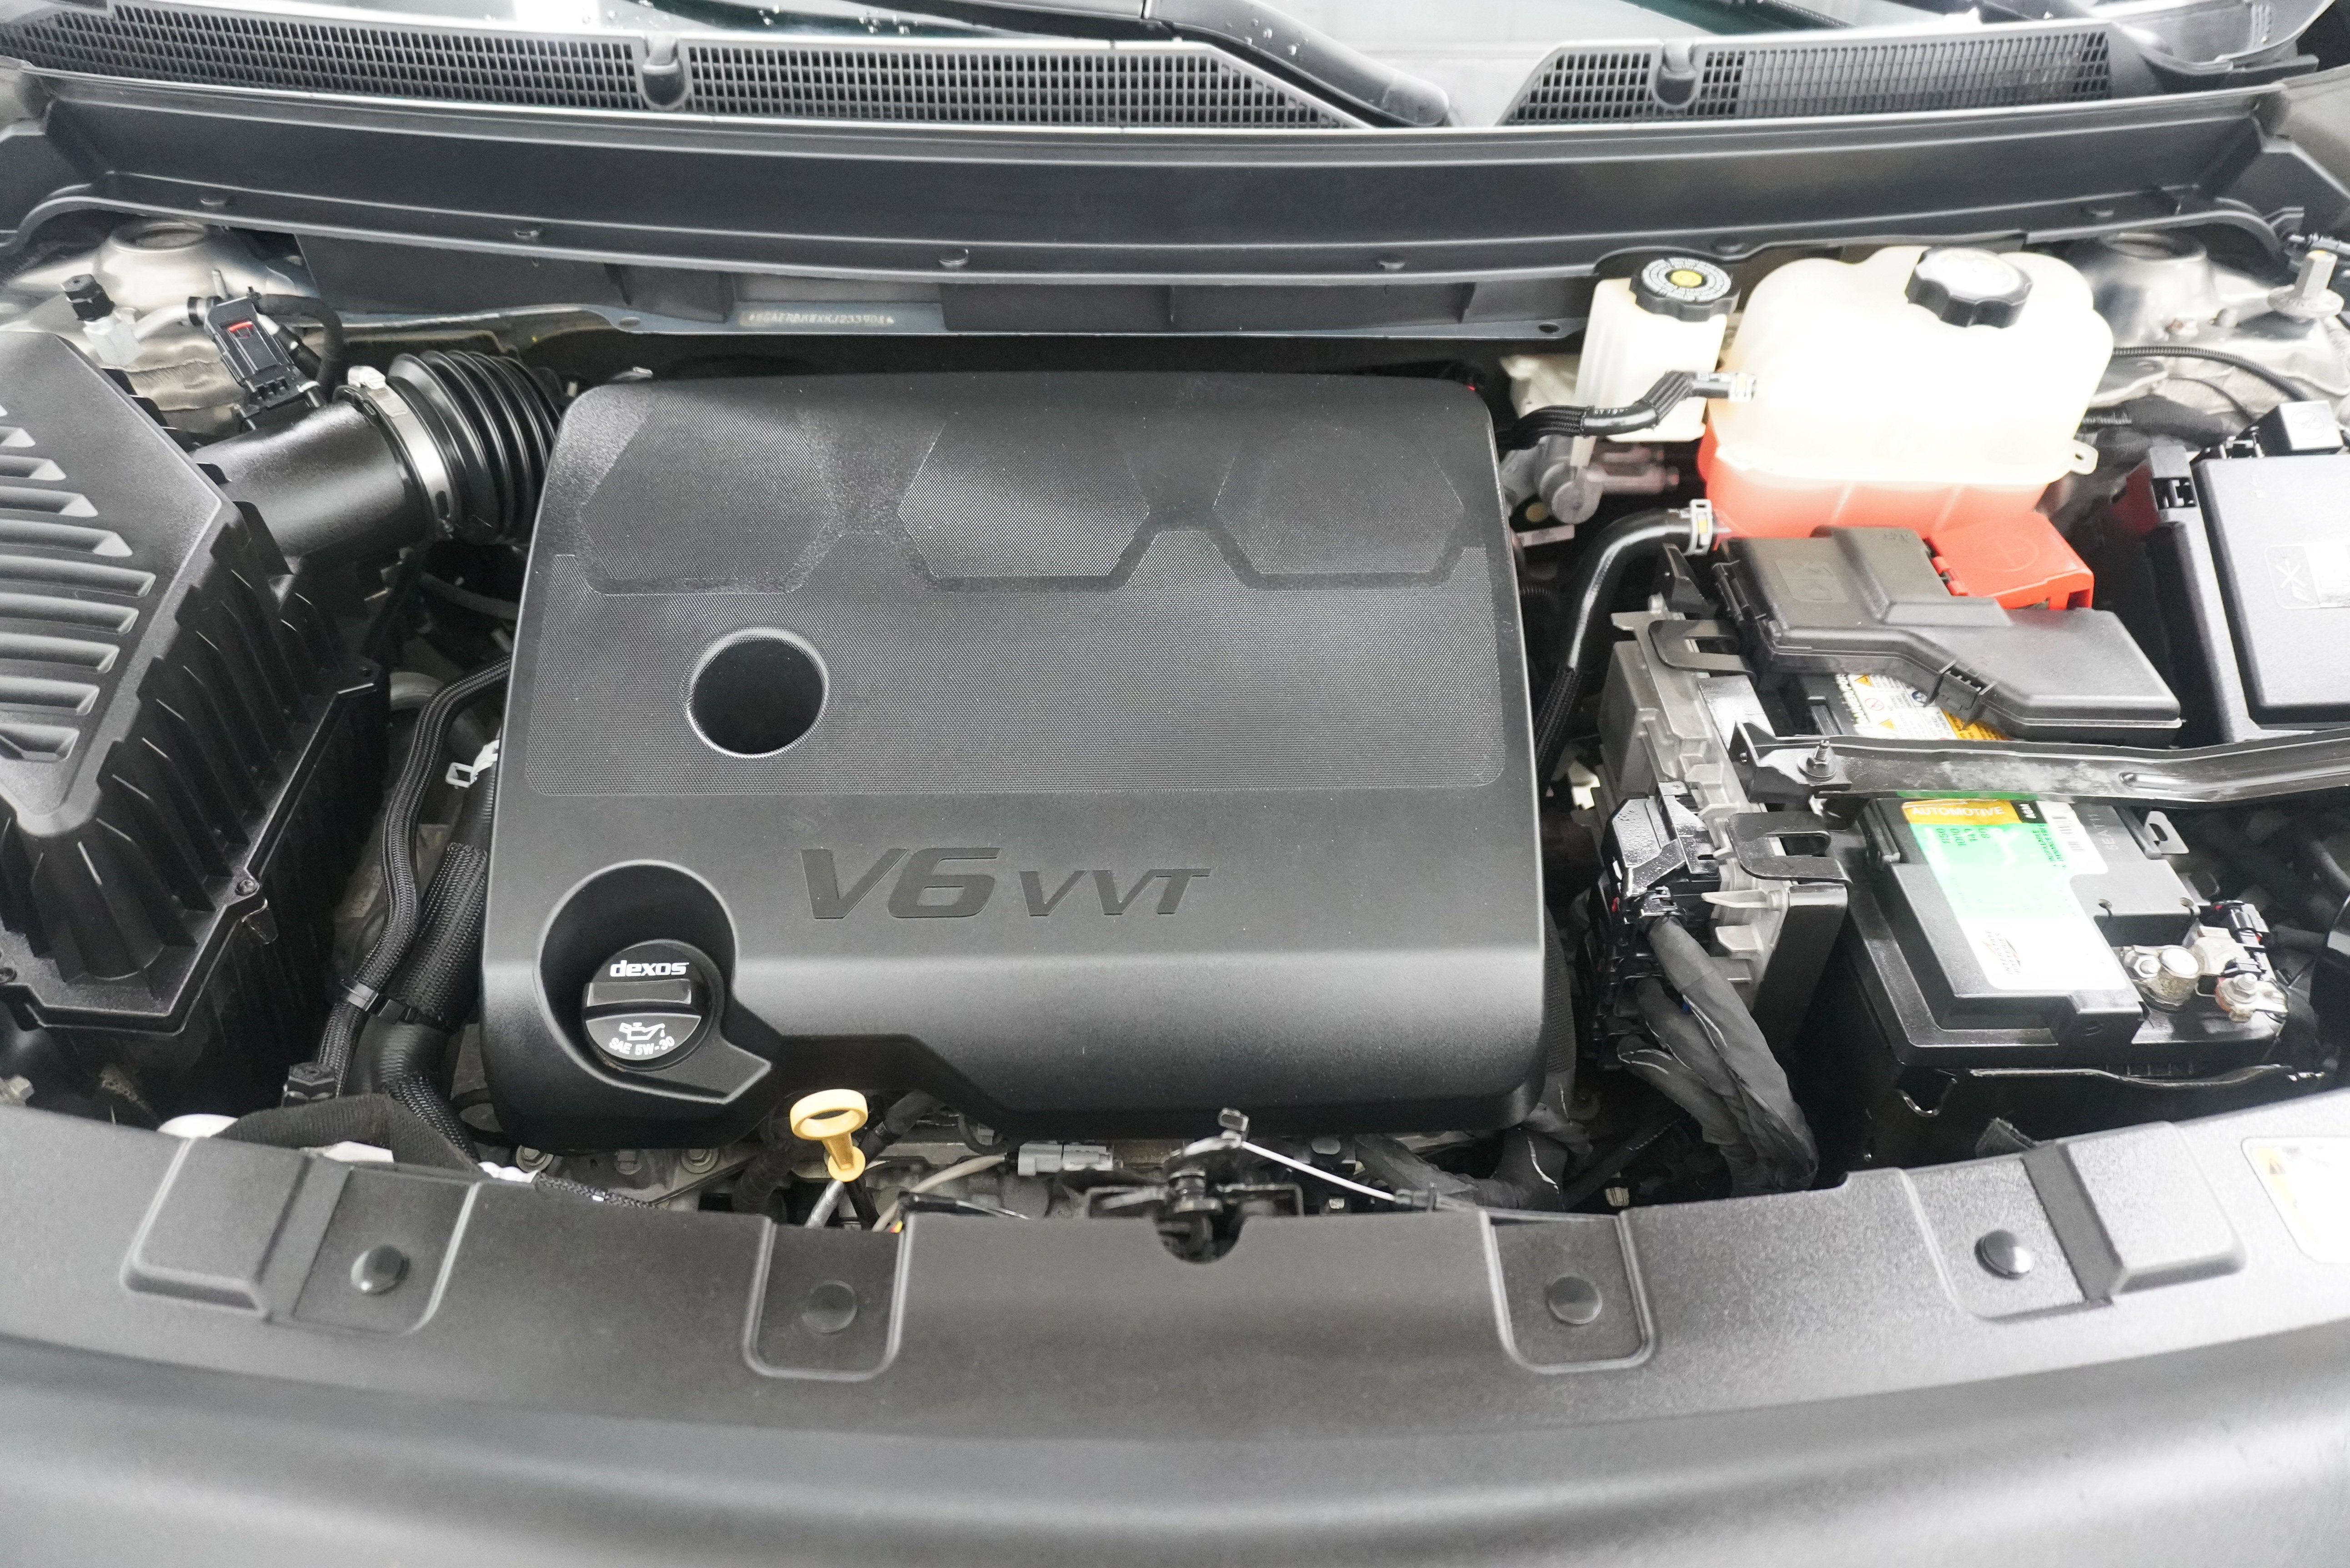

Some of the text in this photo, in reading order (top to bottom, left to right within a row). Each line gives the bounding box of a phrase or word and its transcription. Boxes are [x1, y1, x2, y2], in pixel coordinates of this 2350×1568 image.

[1912, 806, 2004, 817] AUTOMOTIVE
[2019, 803, 2037, 819] AGM
[1936, 828, 1951, 844] 850
[1950, 828, 1967, 847] 1000
[800, 847, 1211, 920] V6 VVT
[610, 960, 689, 977] dexos
[609, 1035, 675, 1055] SAE 5W-30
